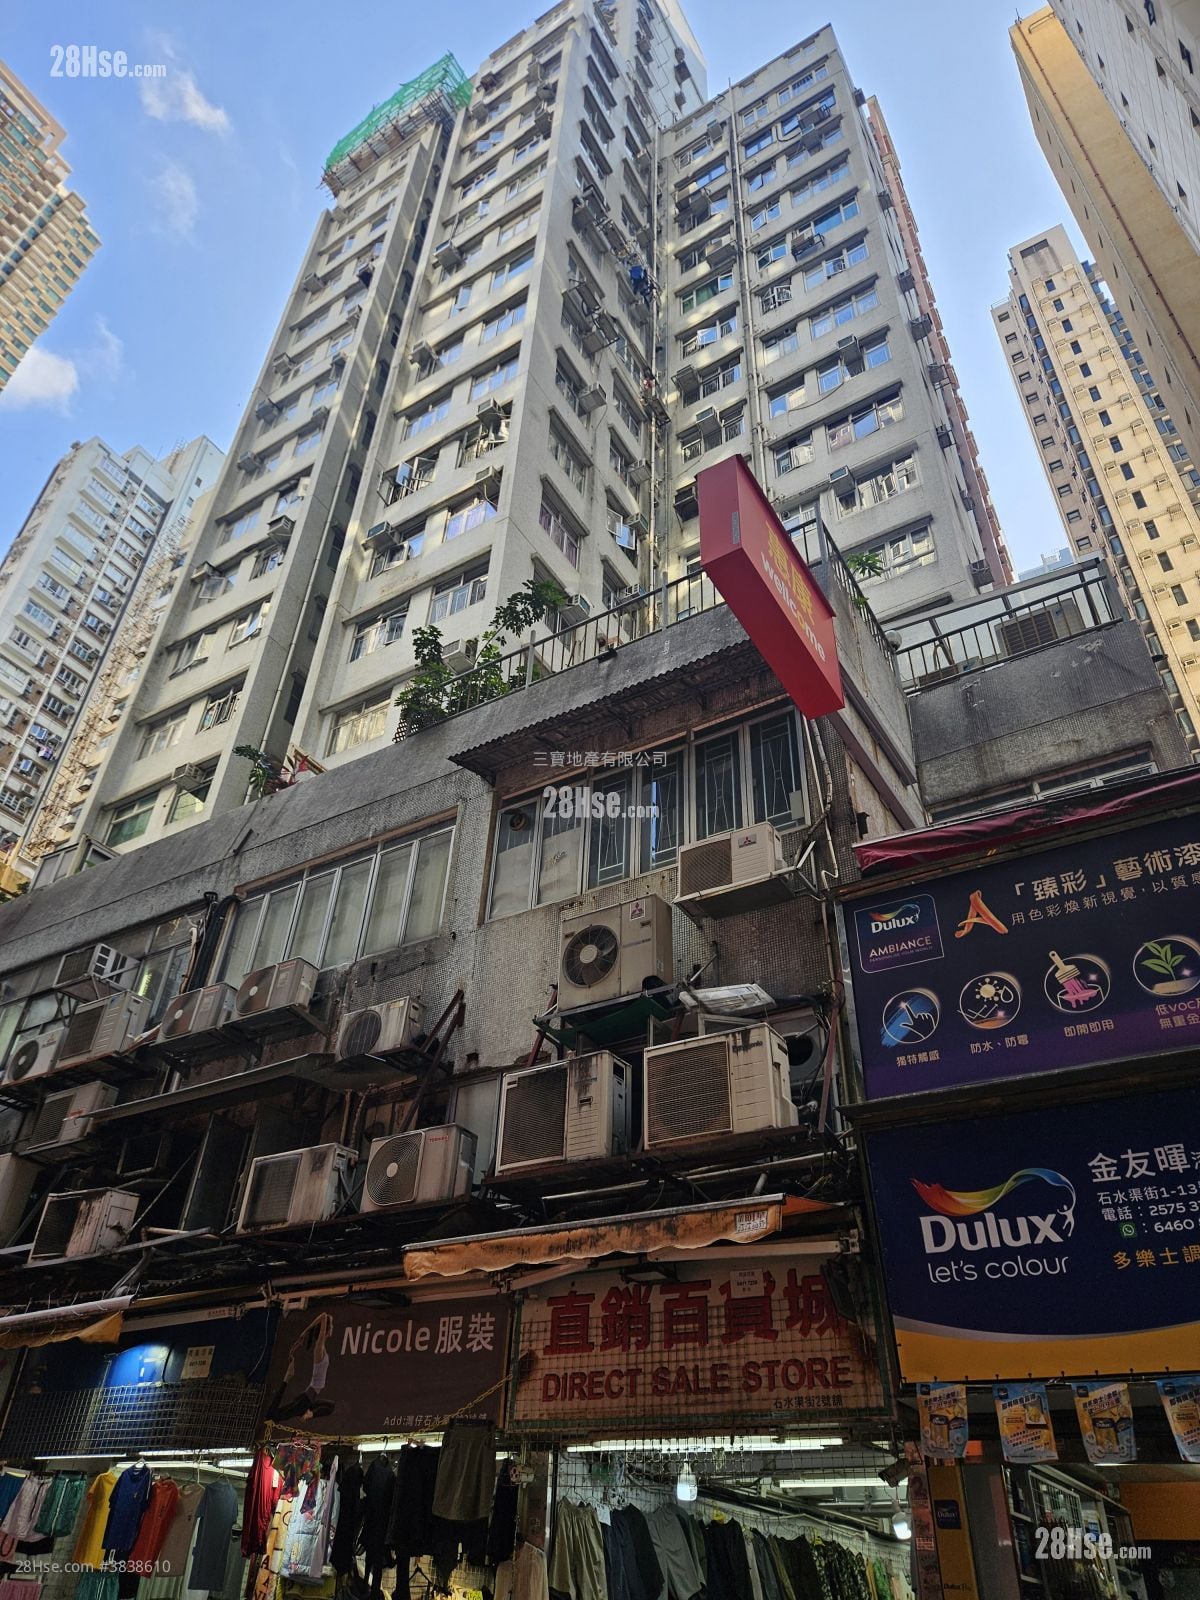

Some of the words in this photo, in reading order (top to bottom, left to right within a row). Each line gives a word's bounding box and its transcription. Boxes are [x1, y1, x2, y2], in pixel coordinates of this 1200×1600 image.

[760, 551, 826, 663] wellcome
[871, 916, 916, 934] Dulux
[869, 935, 932, 958] AMBIANCE
[1155, 998, 1200, 1017] 低VOC
[1063, 1019, 1115, 1037] 即開即用
[1087, 1142, 1200, 1183] 金友暉
[1096, 1180, 1200, 1206] 石水渠街1-13
[1149, 1202, 1186, 1217] 2575
[919, 1211, 1064, 1254] Dulux
[1154, 1218, 1195, 1233] 6460
[928, 1258, 978, 1284] let's
[985, 1254, 1070, 1279] colour
[1112, 1243, 1200, 1270] 多樂士調
[340, 1319, 431, 1356] Nicole
[434, 1311, 496, 1354] 服裝
[541, 1367, 642, 1402] DIRECT
[652, 1363, 731, 1396] SALE
[742, 1355, 853, 1393] STORE
